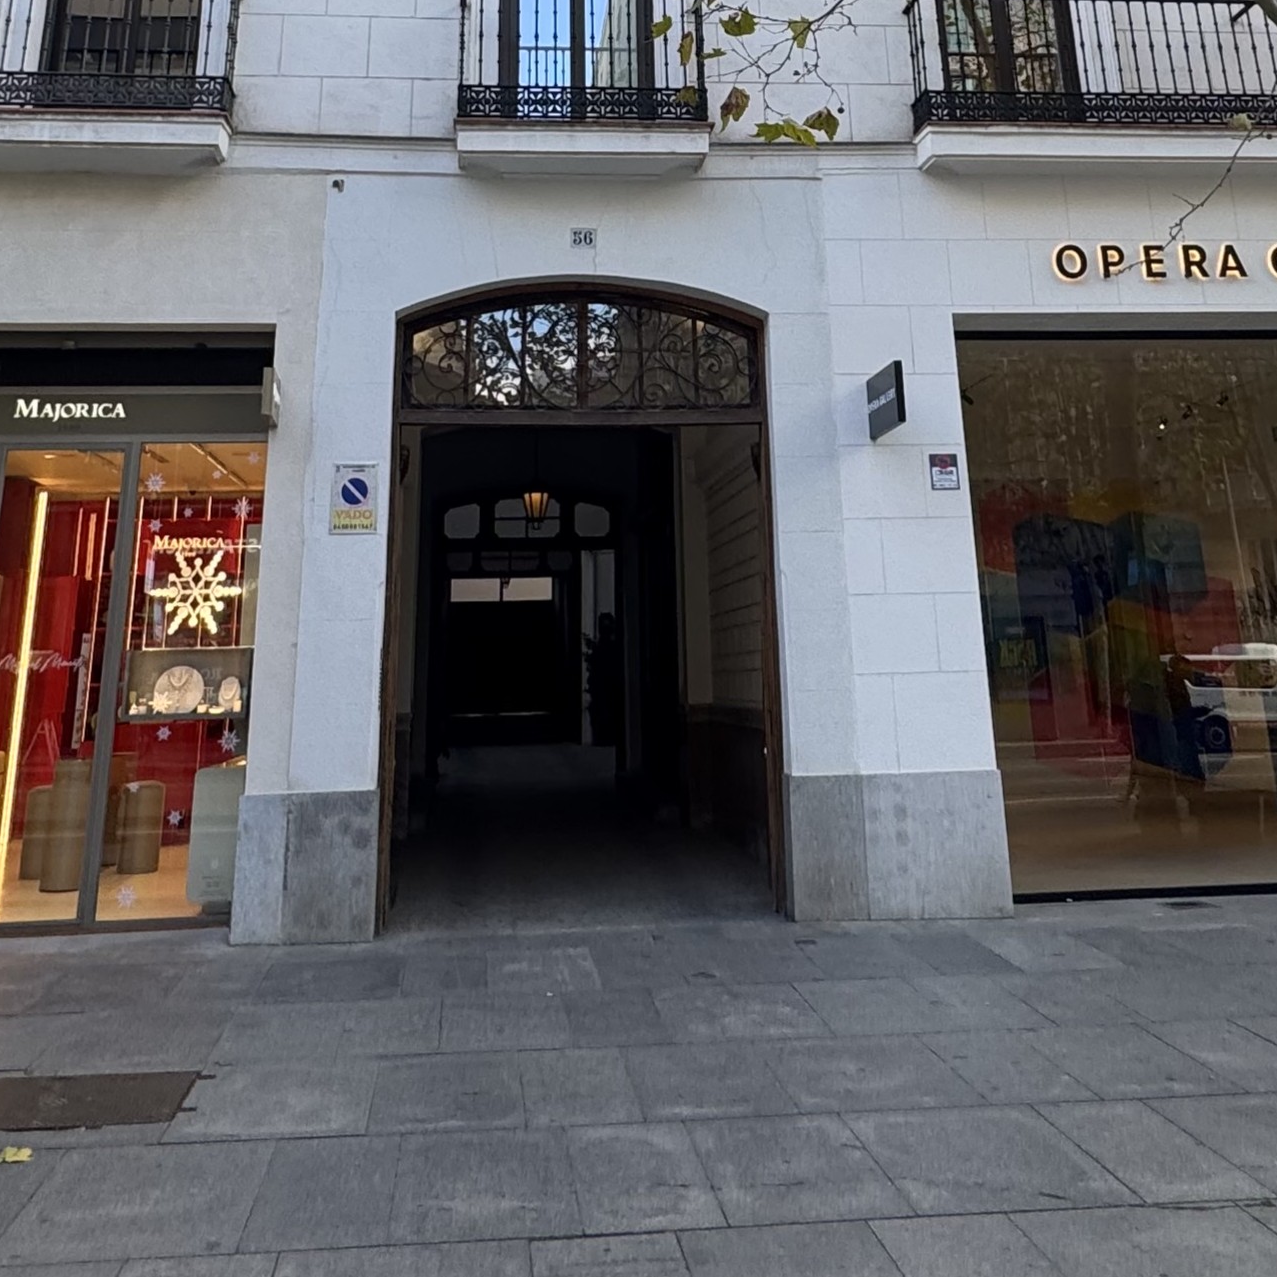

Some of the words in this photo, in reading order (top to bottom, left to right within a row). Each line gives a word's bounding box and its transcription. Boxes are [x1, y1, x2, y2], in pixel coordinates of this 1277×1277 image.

[572, 230, 593, 246] 56
[1053, 243, 1249, 280] OPERA
[13, 398, 126, 422] MAJORICA
[334, 510, 373, 520] VADO
